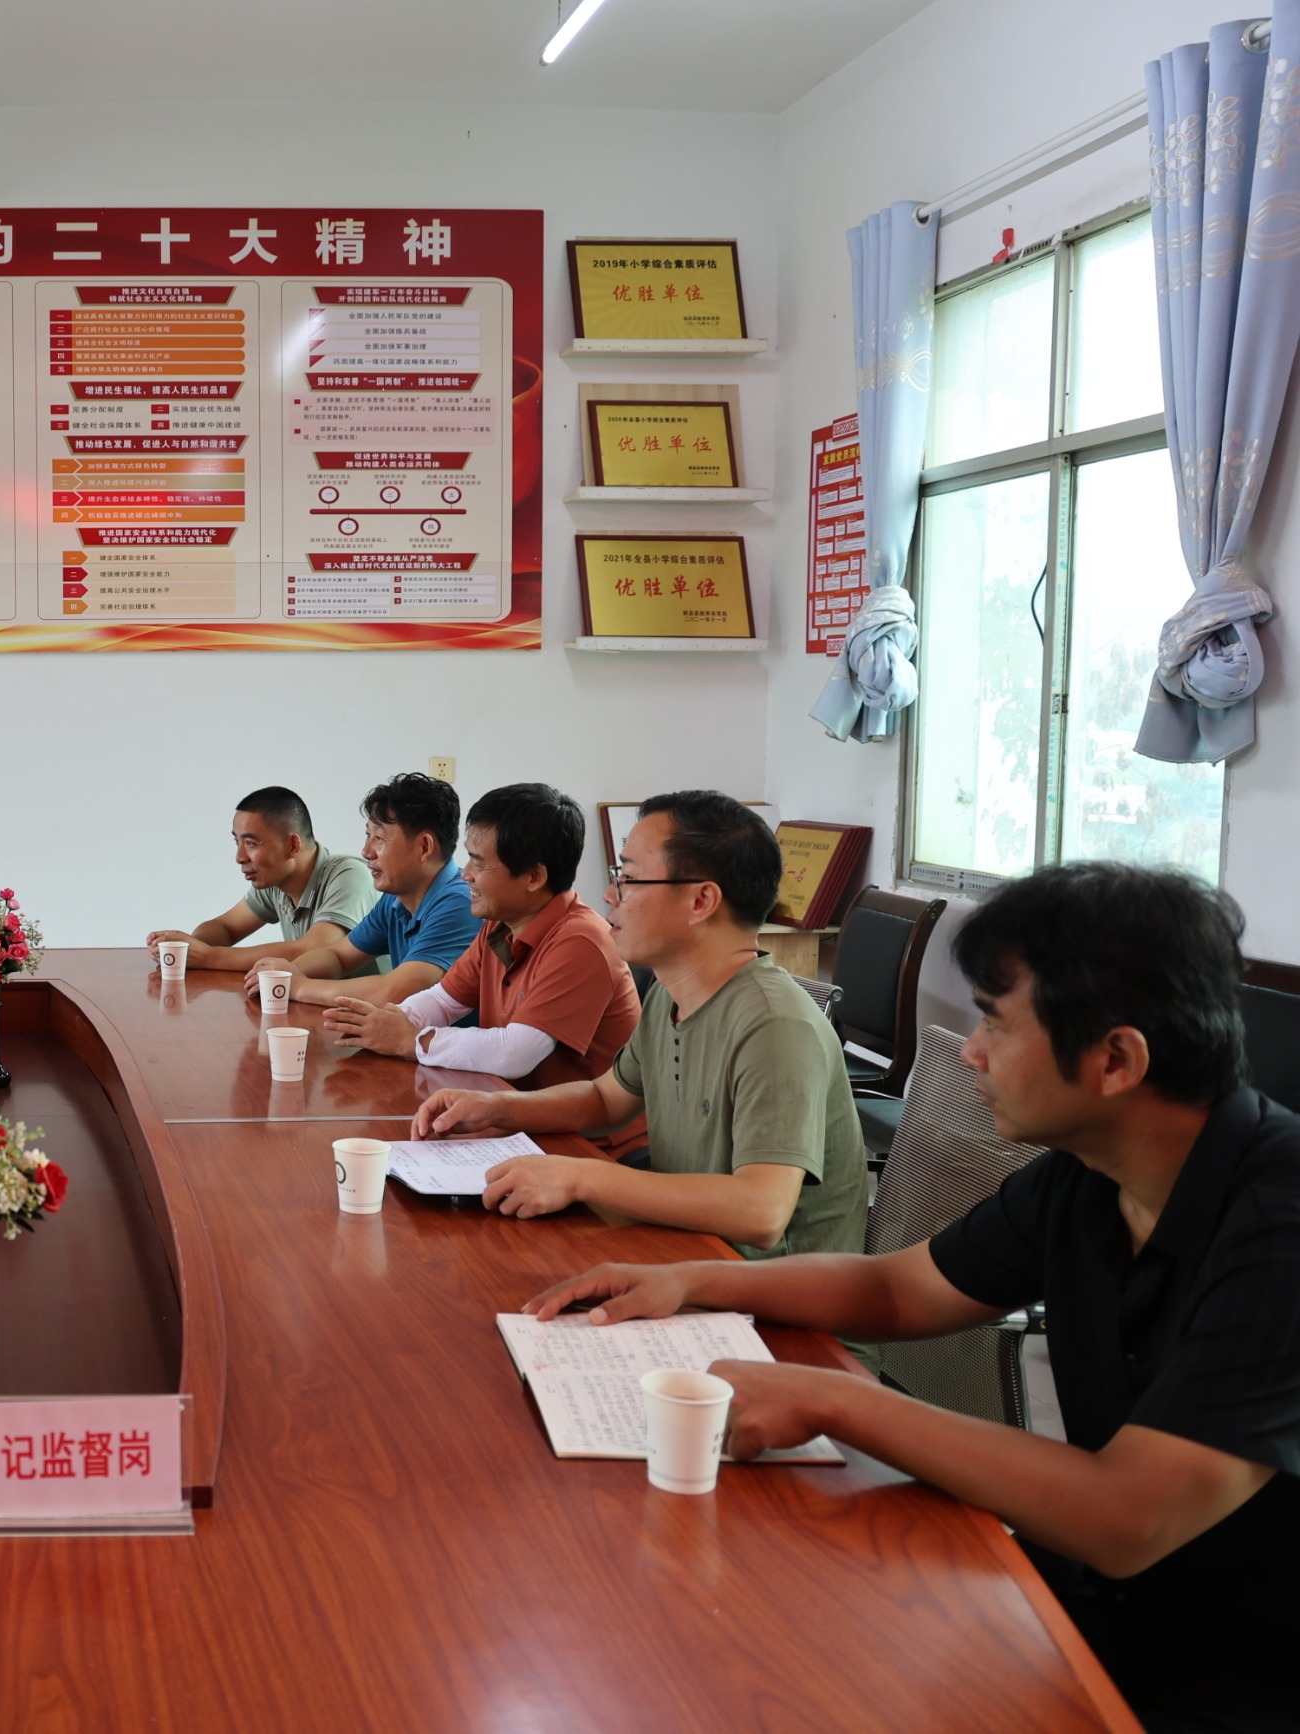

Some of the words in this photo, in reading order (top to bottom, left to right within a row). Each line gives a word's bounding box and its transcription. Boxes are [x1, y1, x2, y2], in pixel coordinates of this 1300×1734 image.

[593, 259, 717, 269] 2019年小学综合素质评估
[347, 288, 439, 296] 实现建军一百年奋斗目标
[613, 283, 704, 303] 优胜单位
[109, 295, 202, 303] 铸就社会主义文化新辉煌
[349, 312, 442, 320] 全面加强人民军队党的建设
[333, 358, 458, 366] 巩固提高一体化国家战略体系和能力
[85, 385, 228, 395] 增进民生福祉，提高人民生活品质
[75, 439, 237, 449] 推动绿色发展，促进人与自然和谐共生
[617, 434, 713, 454] 优胜单位
[103, 536, 212, 544] 坚决维护国家安全和社会稳定
[603, 554, 724, 565] 2021年全县小学综合素质评估
[615, 575, 720, 599] 优胜单位
